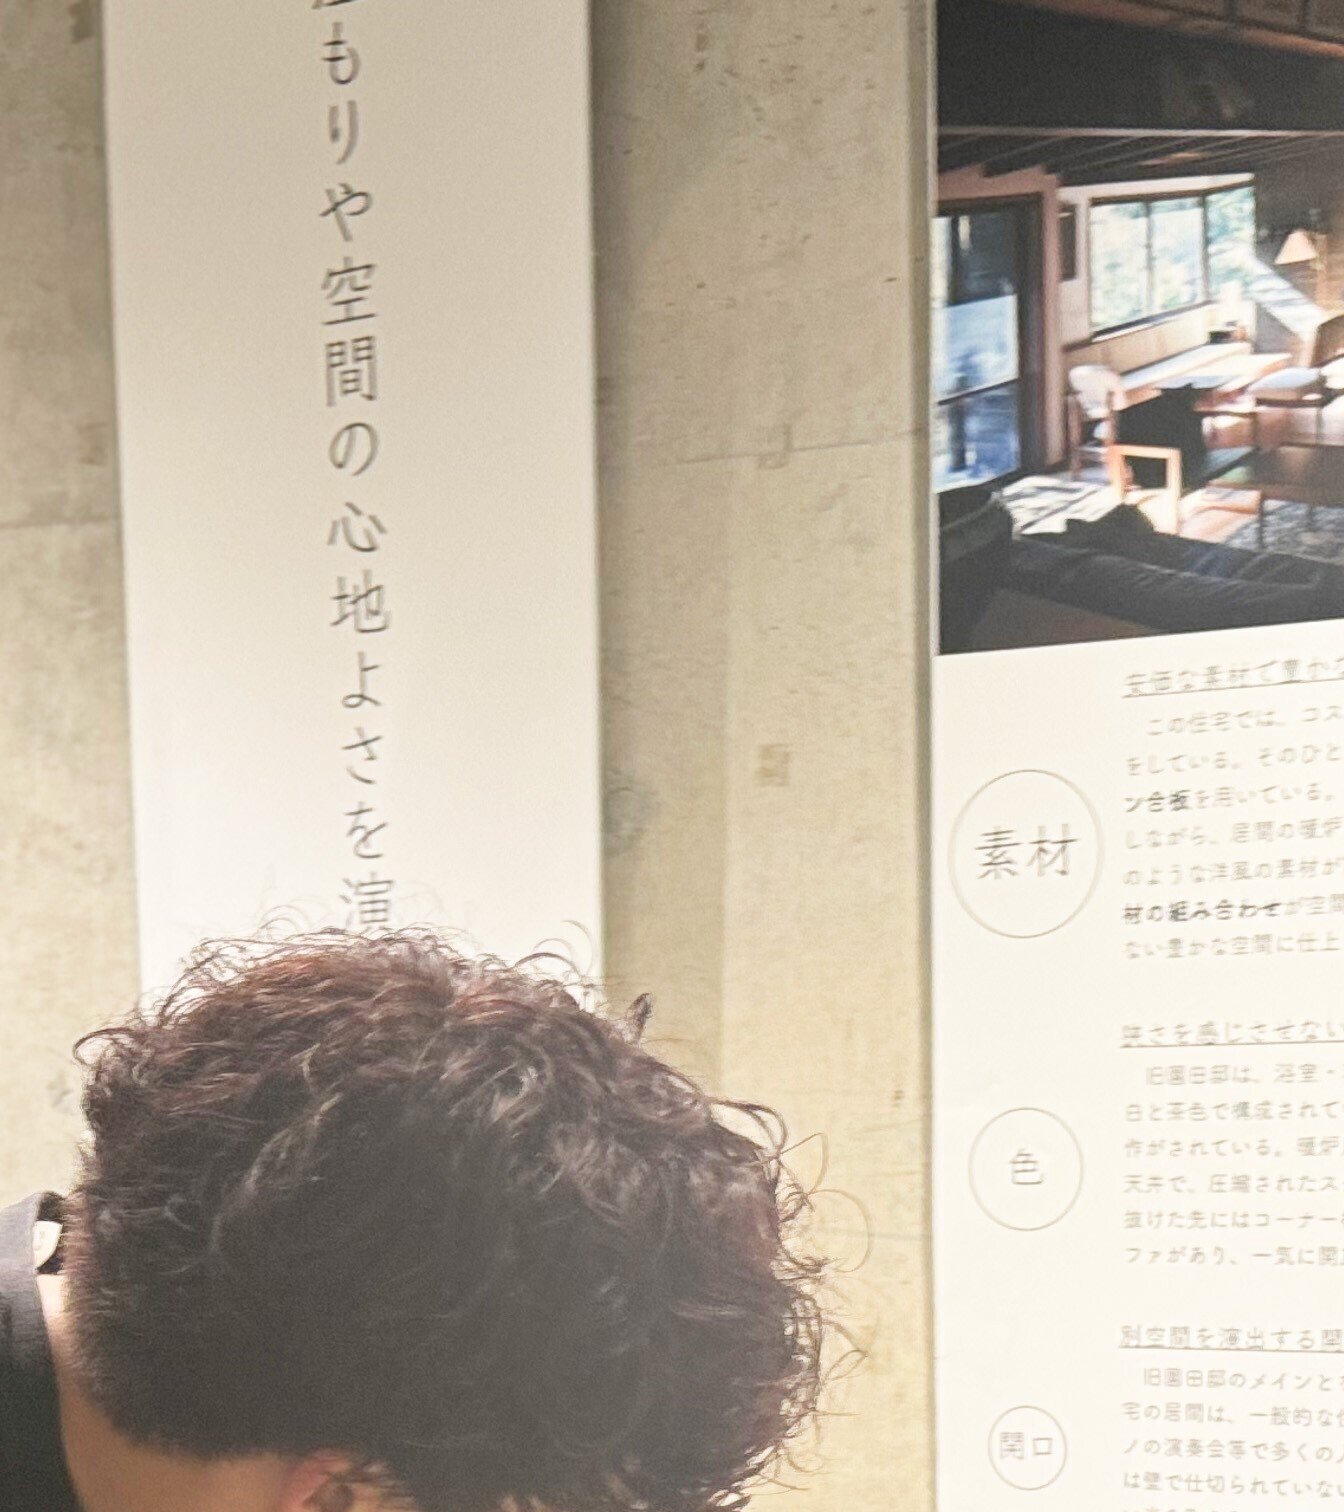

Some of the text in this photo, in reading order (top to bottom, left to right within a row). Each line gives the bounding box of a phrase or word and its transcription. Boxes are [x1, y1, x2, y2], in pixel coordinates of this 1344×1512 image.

[311, 0, 393, 929] もりや空間の心地よさを演
[974, 823, 1078, 881] 素材
[1008, 1147, 1044, 1187] 色
[999, 1430, 1054, 1462] 開口
